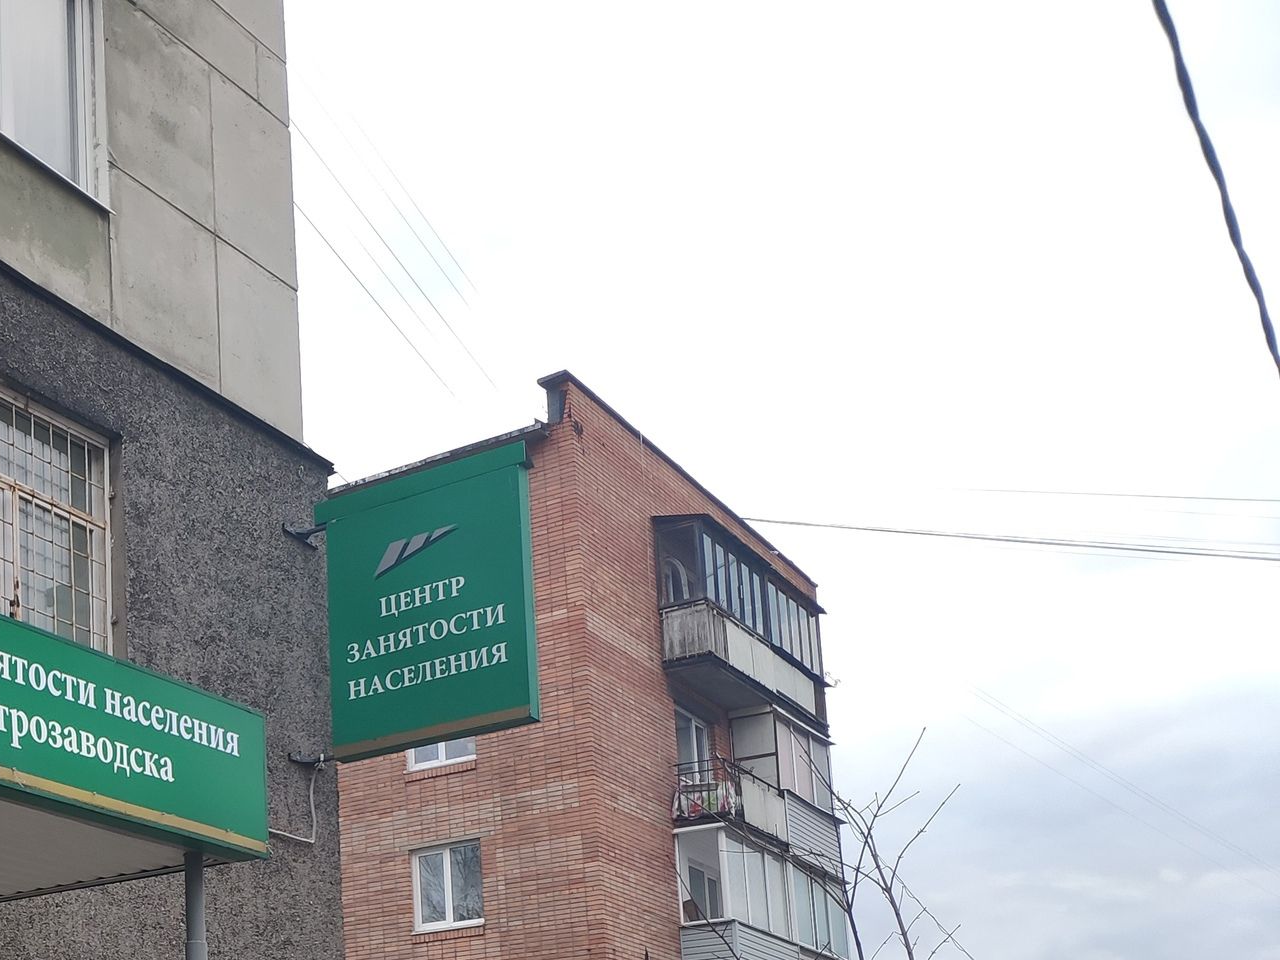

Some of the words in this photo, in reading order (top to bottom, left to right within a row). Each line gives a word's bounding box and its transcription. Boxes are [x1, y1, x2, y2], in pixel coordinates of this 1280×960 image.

[378, 575, 465, 618] ЦЕНТР
[347, 603, 506, 664] ЗАНЯТОСТИ
[347, 642, 508, 701] НАСЕЛЕНИЯ
[104, 687, 241, 758] населения
